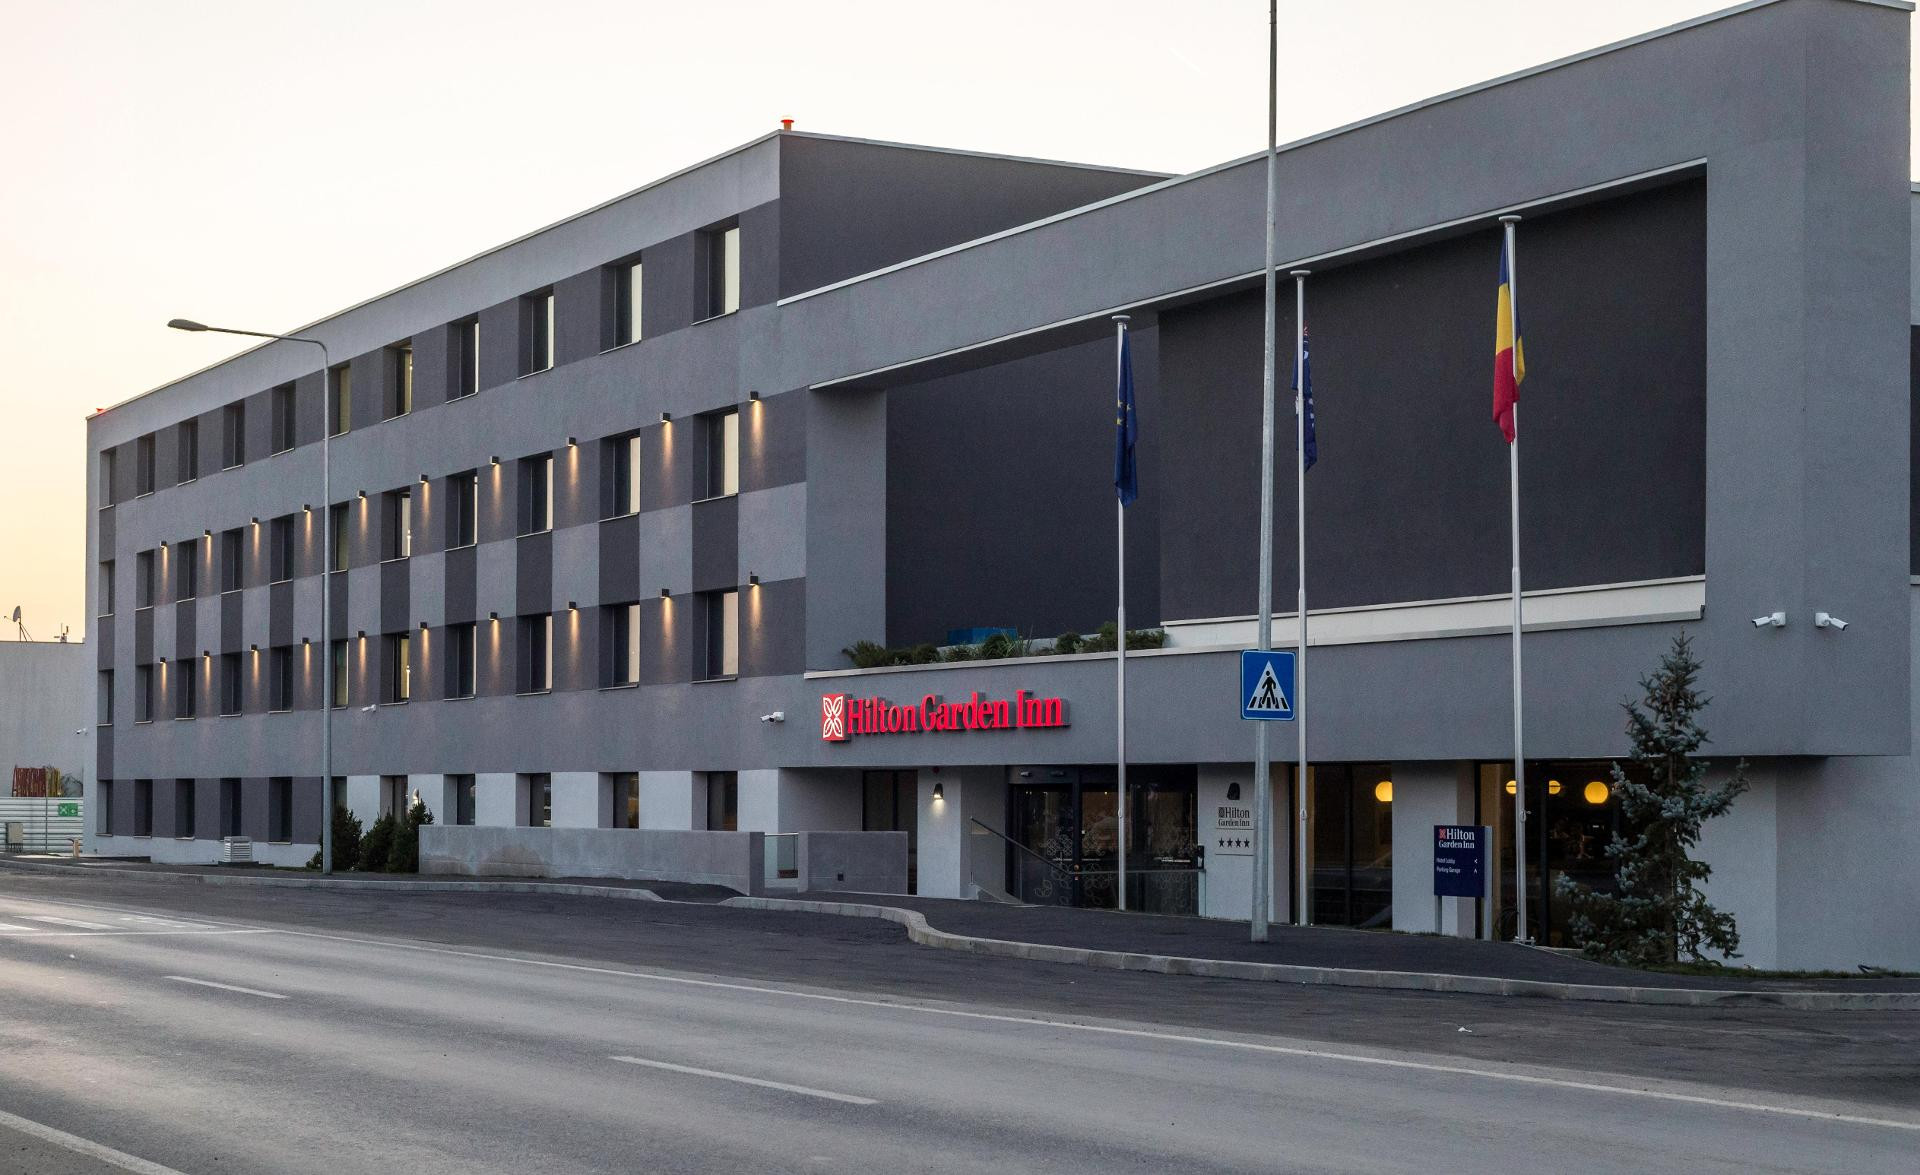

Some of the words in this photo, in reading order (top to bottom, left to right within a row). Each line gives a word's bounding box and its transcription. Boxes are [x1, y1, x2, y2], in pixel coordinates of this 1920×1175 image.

[847, 697, 917, 733] Hilton
[920, 692, 1009, 731] Garden
[1016, 689, 1062, 727] Inn
[1225, 807, 1250, 818] Hilton
[1446, 828, 1475, 840] Hilton
[1438, 840, 1462, 848] Garden
[1463, 840, 1475, 848] Inn
